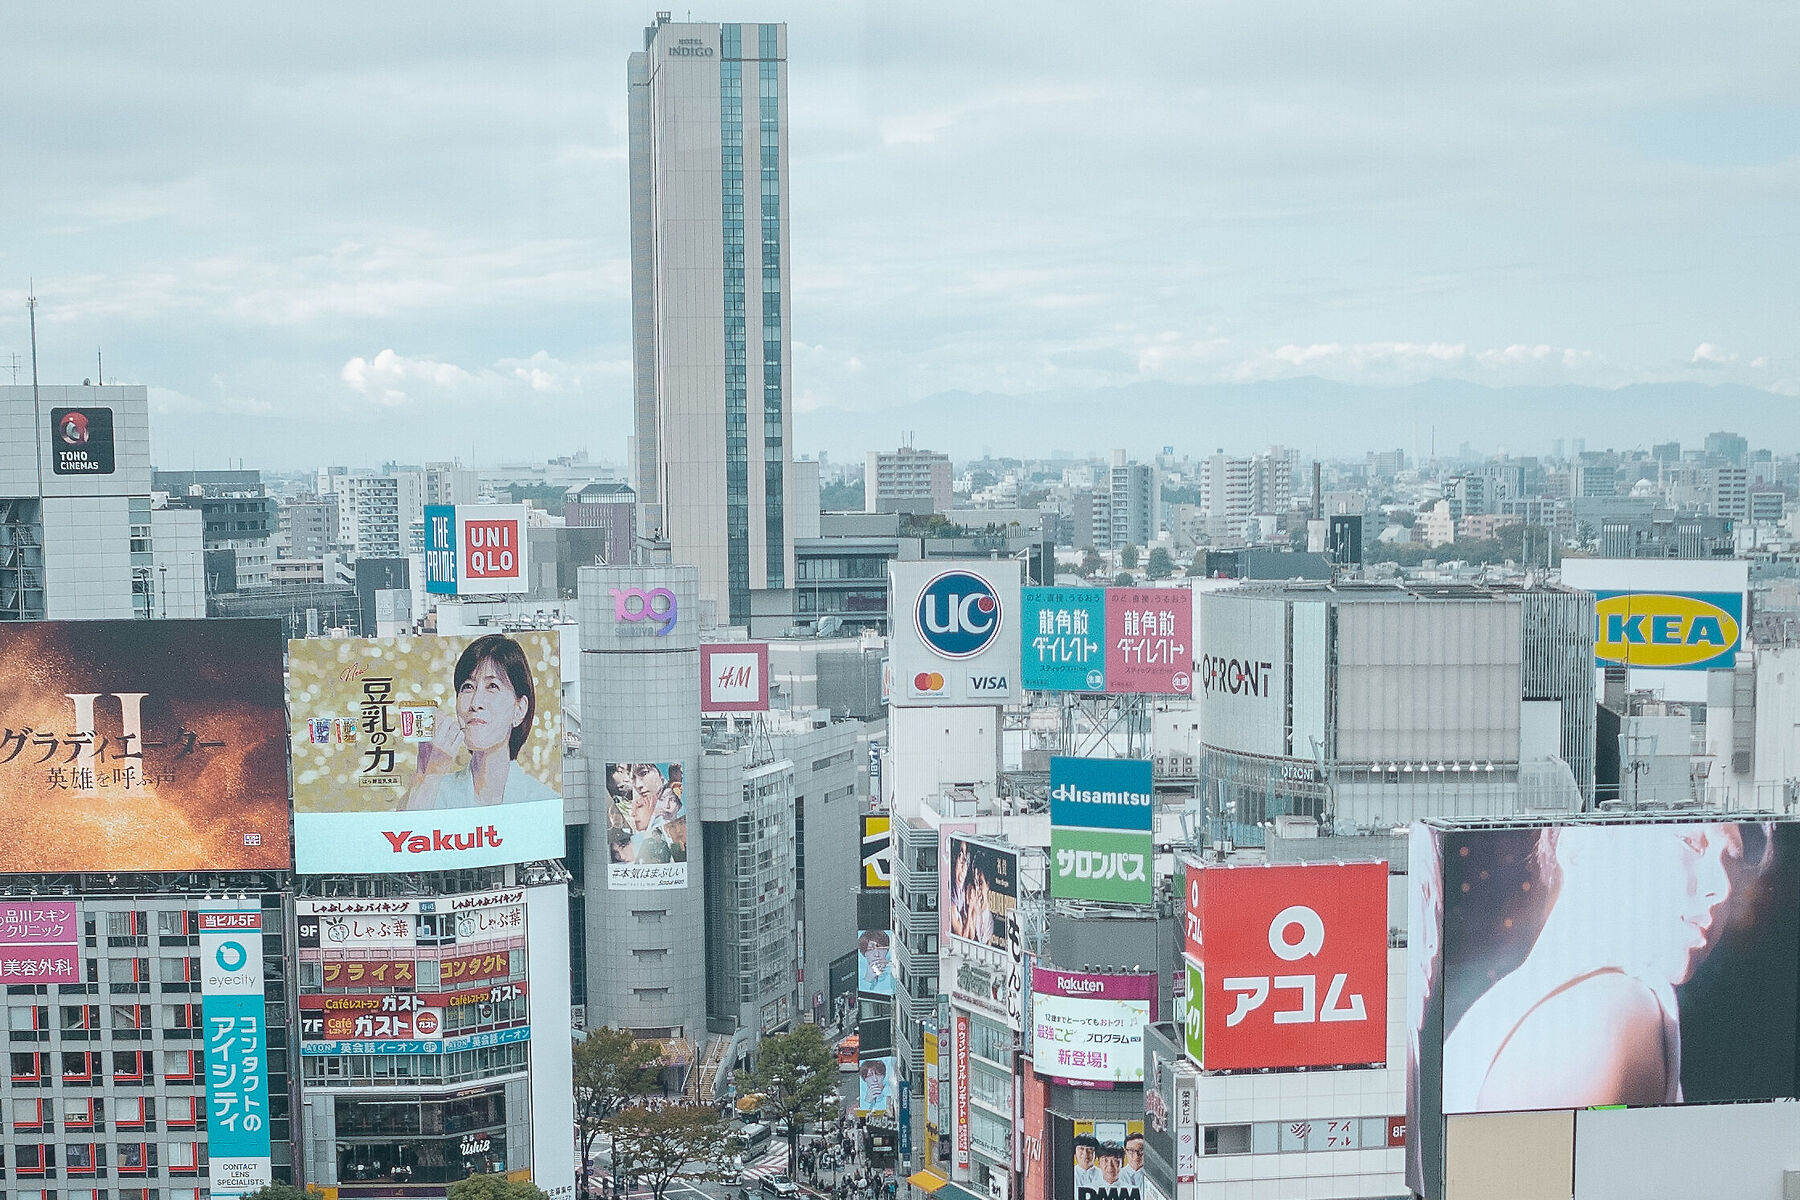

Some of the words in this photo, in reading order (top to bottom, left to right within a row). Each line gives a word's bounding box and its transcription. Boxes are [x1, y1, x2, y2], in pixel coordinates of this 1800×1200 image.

[668, 46, 714, 57] INDIGO
[59, 452, 88, 461] TOHO
[60, 462, 99, 470] CINEMAS
[432, 517, 448, 548] THE
[471, 527, 508, 547] UNI
[427, 551, 455, 582] PRIME
[471, 551, 513, 575] QLO
[609, 588, 678, 637] 109
[1039, 609, 1089, 635] 龍角散
[1124, 610, 1175, 636] 龍角散
[1596, 614, 1726, 645] KEA
[1032, 637, 1099, 662] ダイレクト
[1117, 638, 1185, 664] ダイレクト
[718, 665, 751, 688] H&M
[969, 677, 1008, 690] VISA
[1203, 653, 1272, 699] QFRONT
[360, 677, 395, 773] 豆乳の力
[0, 727, 226, 765] グラディエーター
[65, 692, 150, 798] II
[46, 766, 176, 800] 英雄を呼ぶ声
[1052, 784, 1150, 807] Hisamitsu
[382, 825, 504, 854] Yakult
[1056, 849, 1146, 882] サロンパス
[312, 903, 410, 913] しゃぶしゃぶバイキング
[451, 891, 524, 910] しゃぶしゃぶバイキング
[204, 915, 256, 928] 当ビル5F
[353, 919, 409, 938] しゃぶ葉
[479, 907, 521, 931] しゃぶ葉
[1187, 911, 1203, 945] アコム
[300, 925, 318, 938] 9F
[324, 963, 412, 982] プライス
[441, 955, 507, 979] コンタクト
[208, 974, 257, 988] eyecity
[1057, 976, 1105, 993] Rakuten
[382, 995, 425, 1012] ガスト
[490, 985, 522, 1004] ガスト
[1187, 970, 1201, 1040] レイク
[1223, 973, 1368, 1028] アコム
[303, 1019, 324, 1033] 7F
[328, 1018, 352, 1029] Café
[354, 1015, 409, 1038] ガスト
[418, 1021, 437, 1029] ガスト
[340, 1042, 419, 1054] 英会話イーオン
[471, 1029, 530, 1048] 英会話イーオン
[1058, 1048, 1109, 1069] 新登場!
[210, 1016, 240, 1132] アイシティ
[240, 1016, 262, 1132] コンタクトの
[1392, 1126, 1406, 1137] 8F
[222, 1163, 258, 1171] CONTACT
